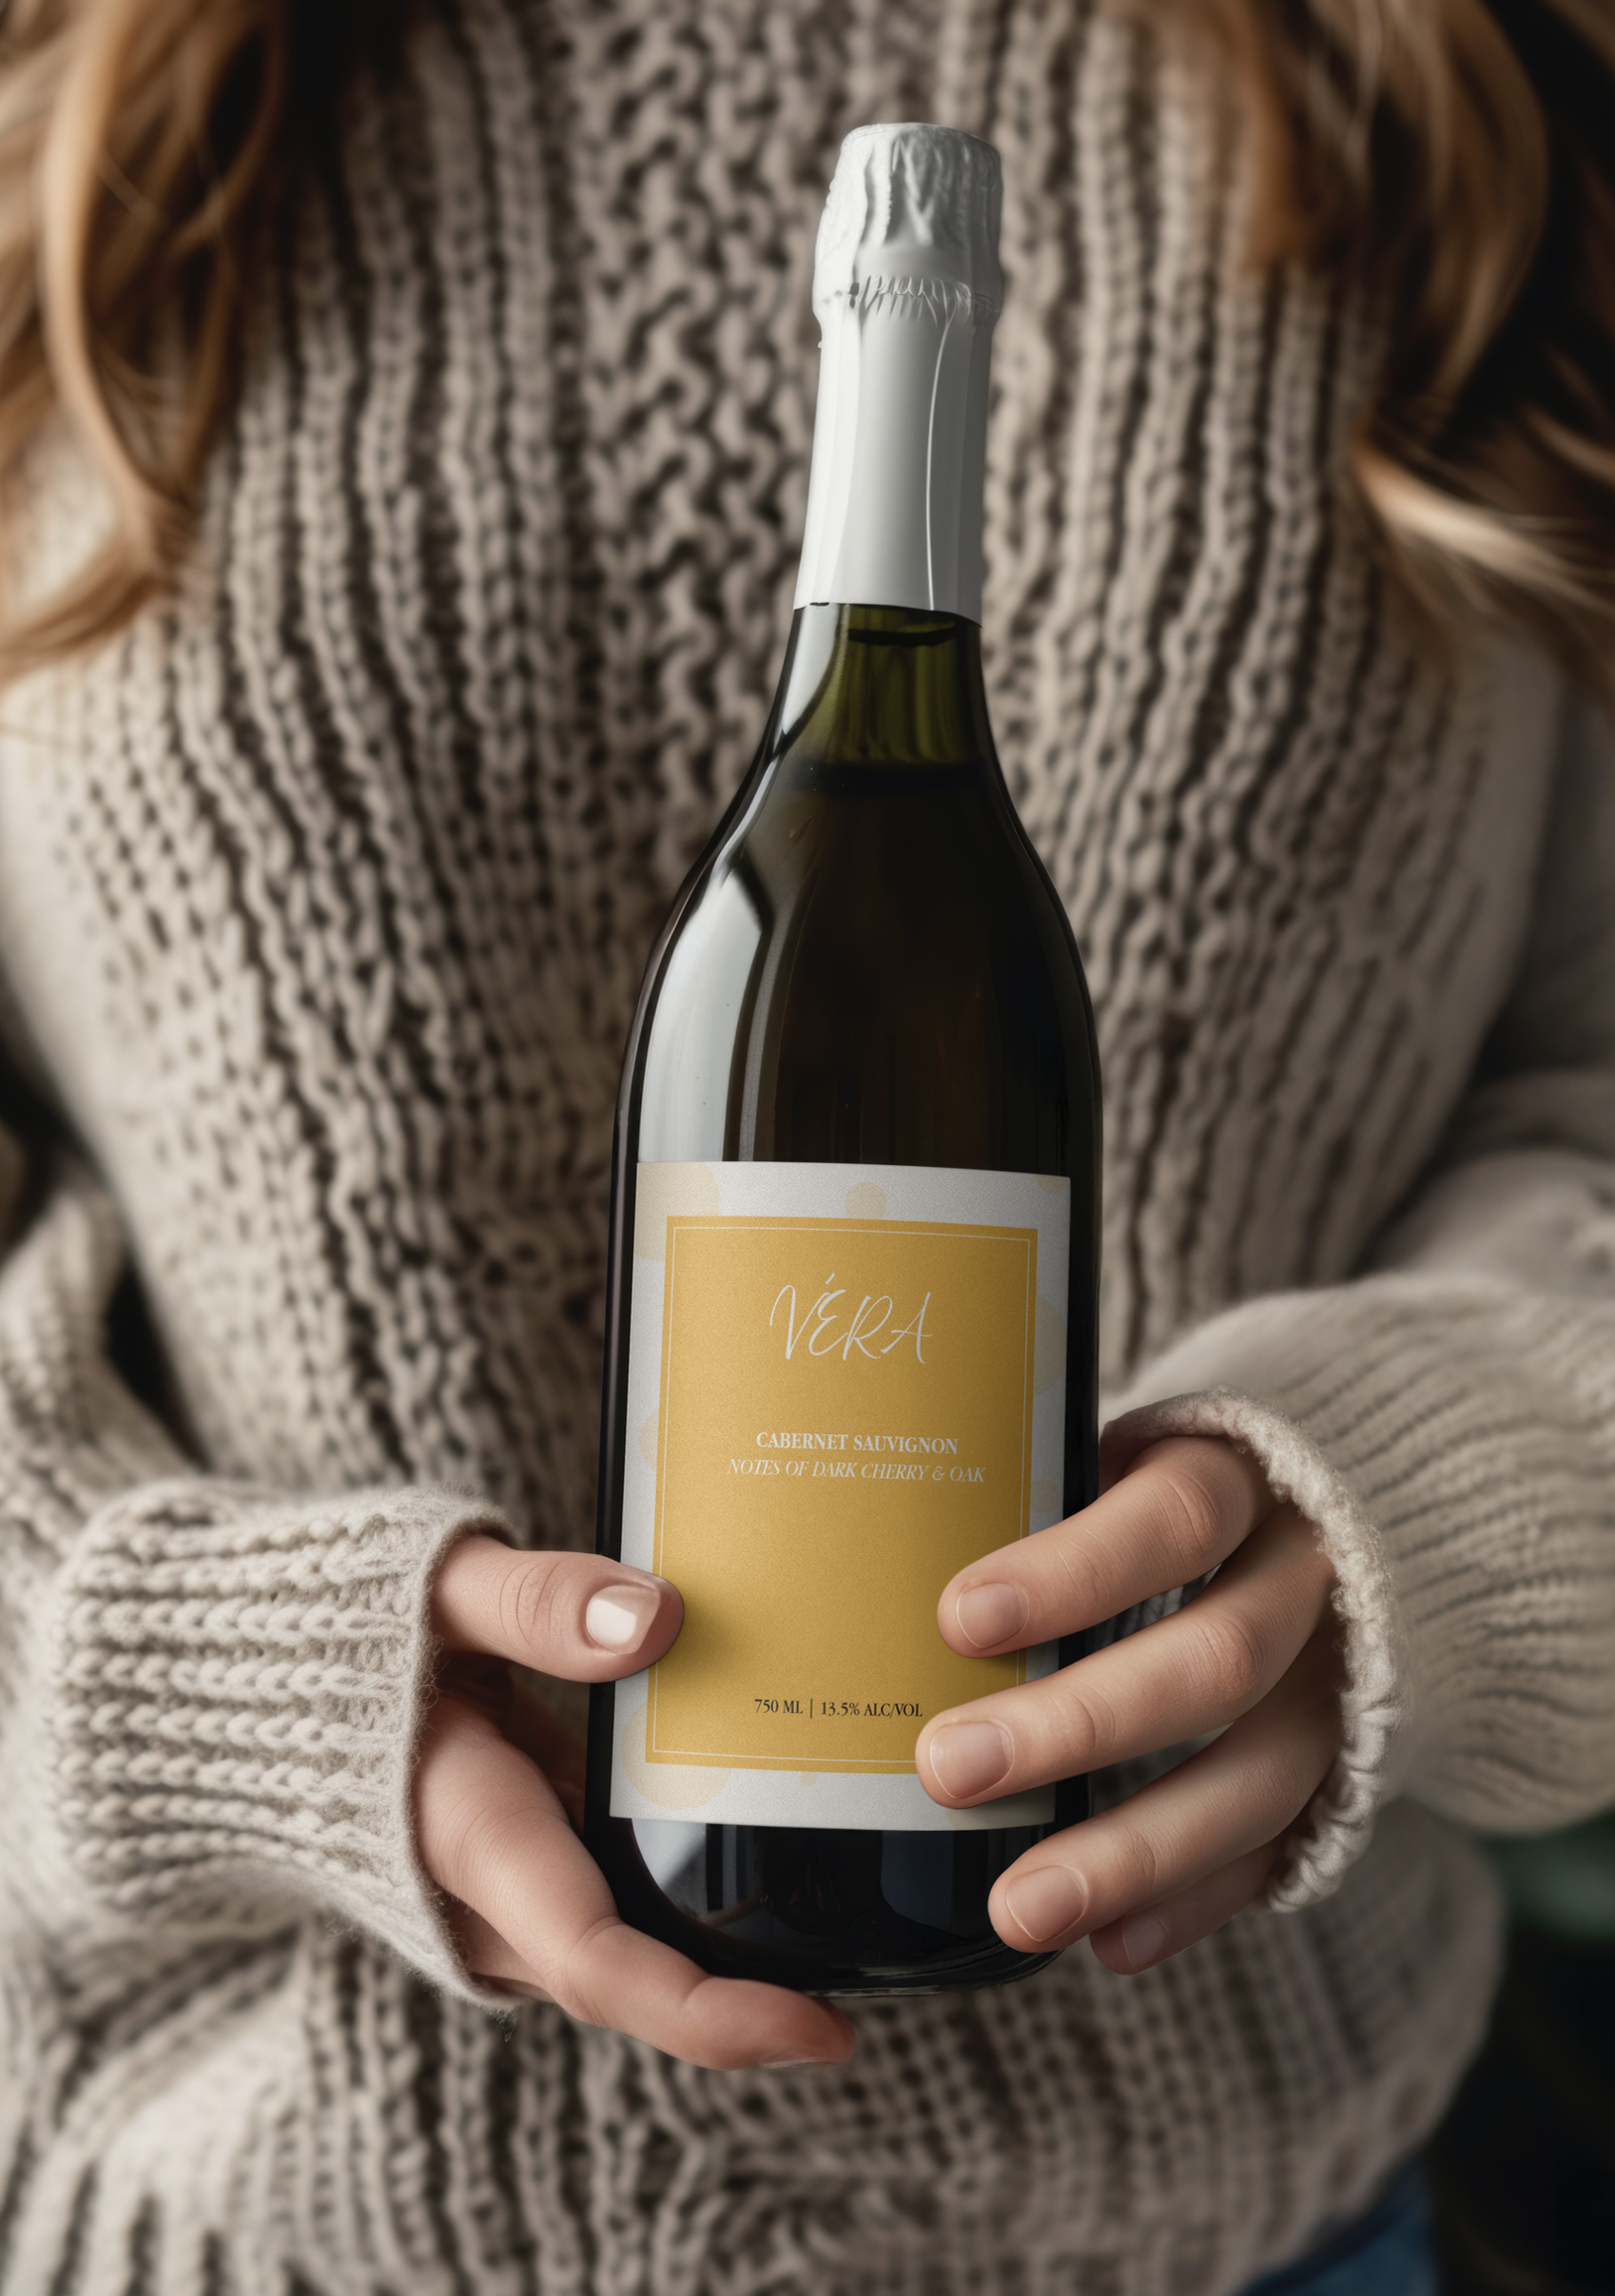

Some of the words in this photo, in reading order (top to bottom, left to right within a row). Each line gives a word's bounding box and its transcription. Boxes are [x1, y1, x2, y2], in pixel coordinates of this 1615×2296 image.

[769, 1273, 932, 1365] VÉRA
[756, 1431, 849, 1450] CABERNET
[853, 1434, 959, 1454] SAUVIGNON
[727, 1458, 782, 1475] NOTES
[786, 1461, 809, 1476] OF
[812, 1461, 858, 1478] DARK
[861, 1463, 929, 1481] CHERRY
[932, 1466, 945, 1481] &
[949, 1466, 986, 1483] OAK
[754, 1699, 779, 1714] 750
[782, 1700, 804, 1715] ML
[821, 1702, 861, 1717] 13.5%
[863, 1703, 923, 1720] ALC/VOL
